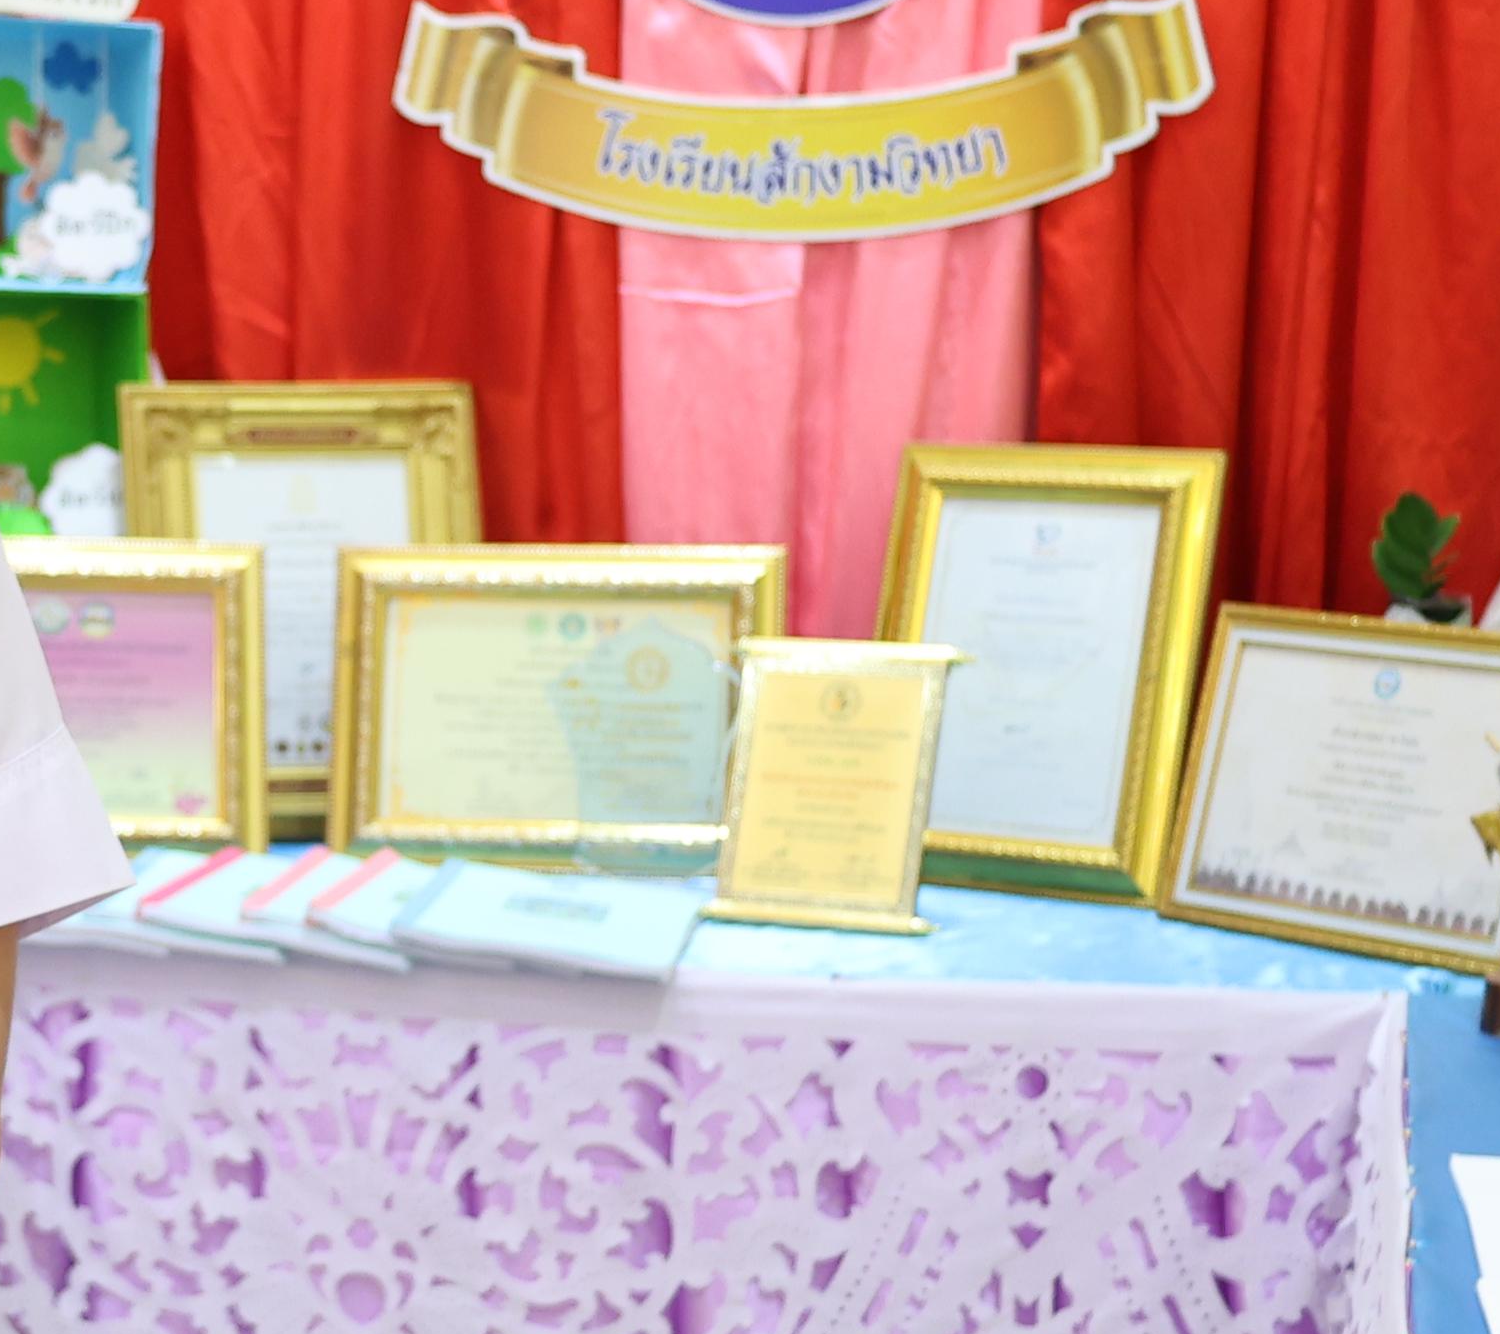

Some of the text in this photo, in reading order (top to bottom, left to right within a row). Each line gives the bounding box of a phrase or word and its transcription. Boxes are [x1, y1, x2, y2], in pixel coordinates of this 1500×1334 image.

[598, 107, 1010, 208] โรงเรียนสักงามวิทยา
